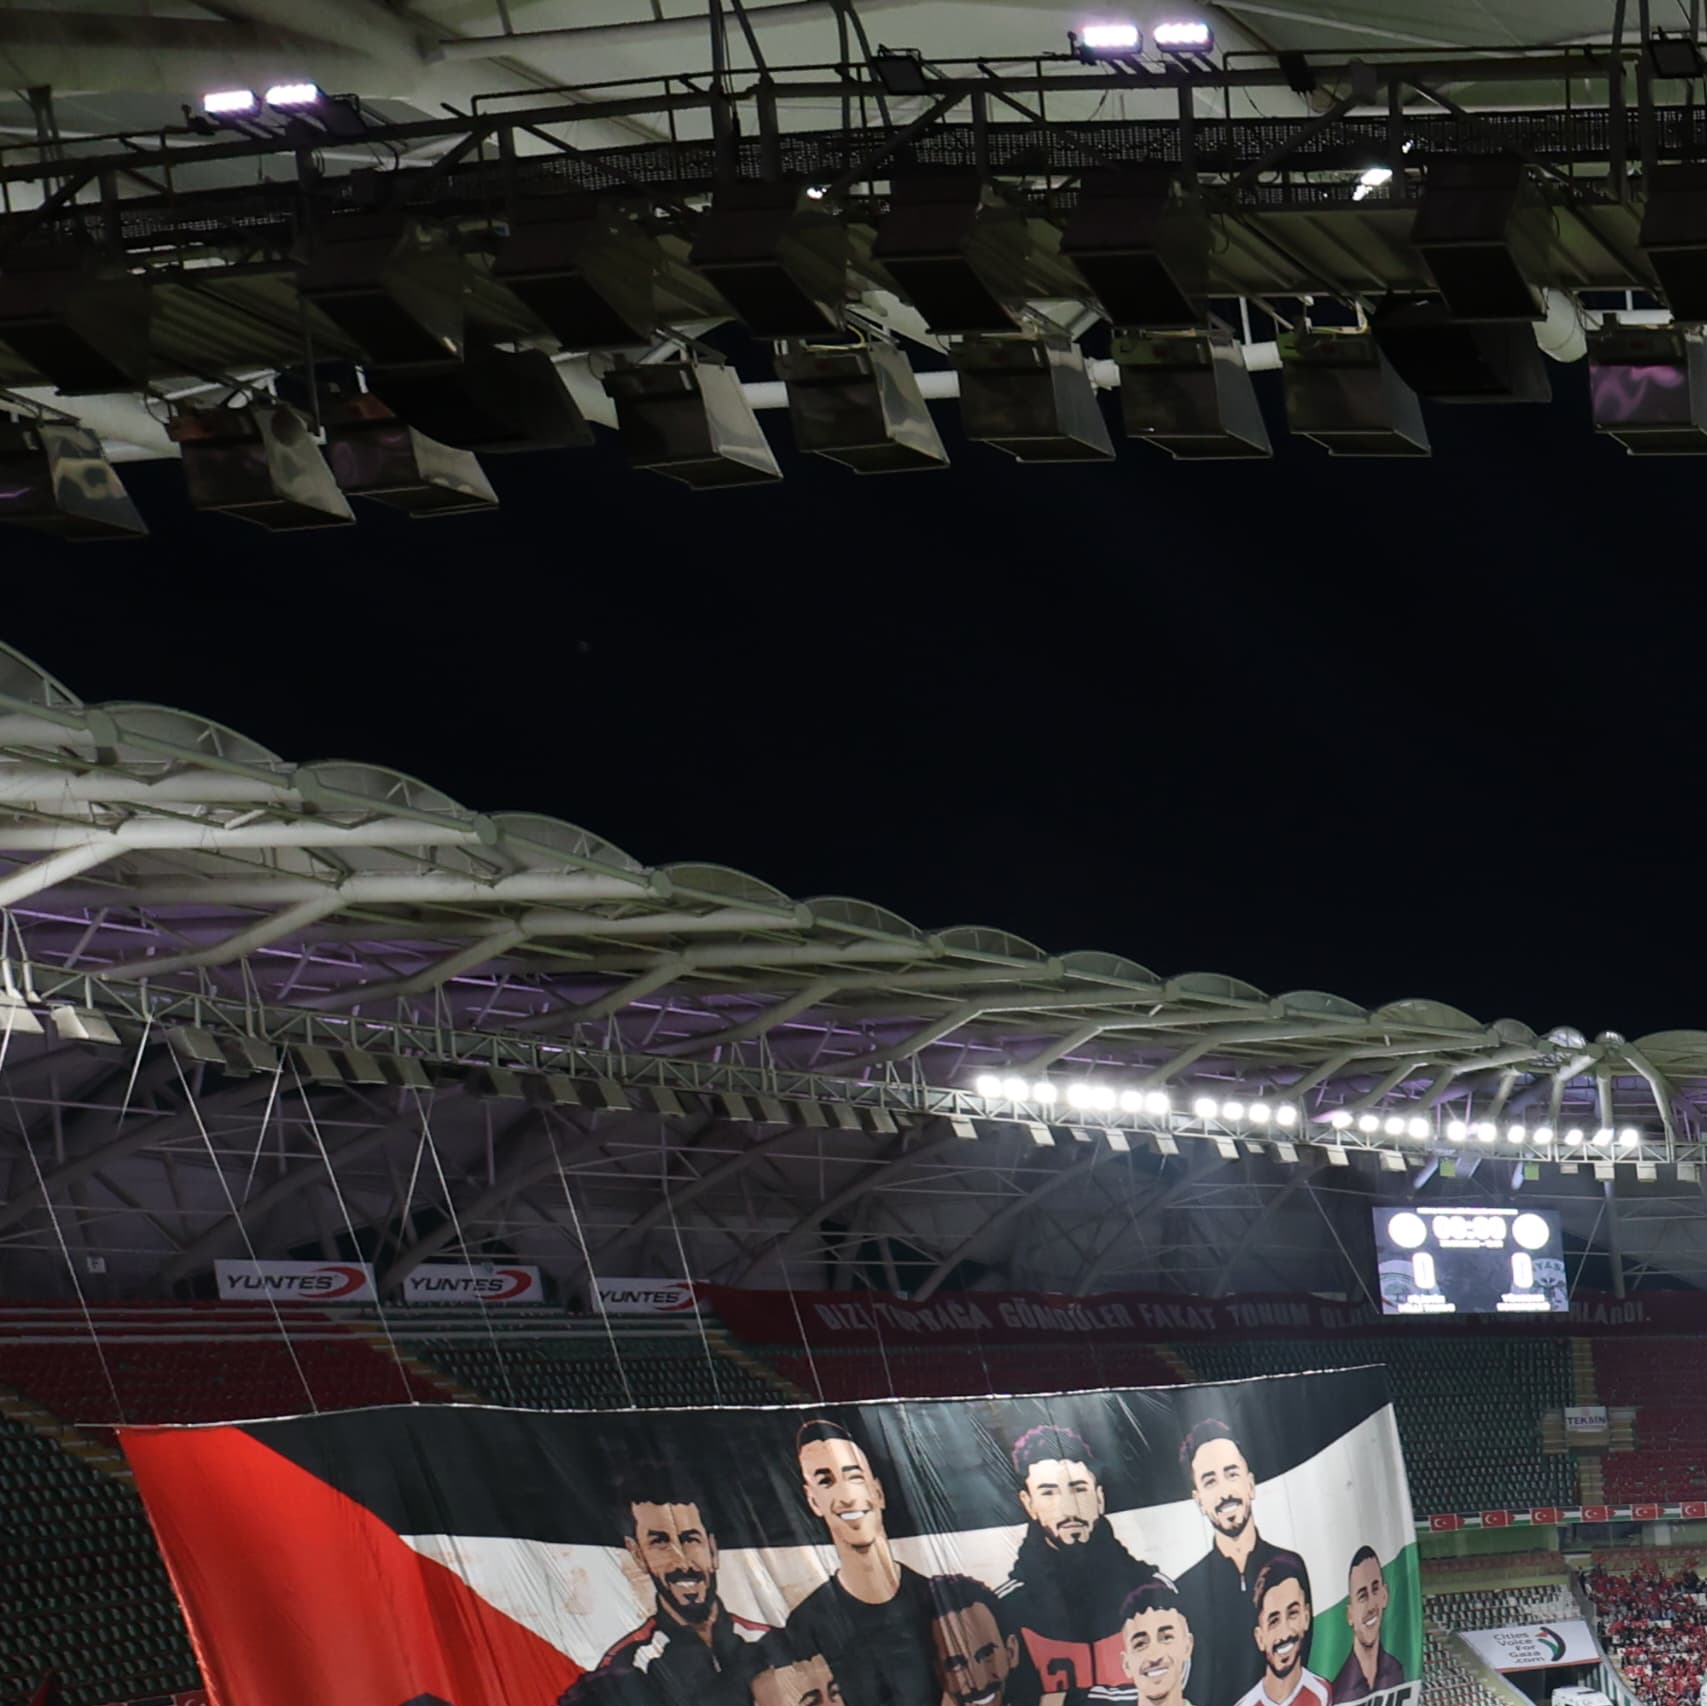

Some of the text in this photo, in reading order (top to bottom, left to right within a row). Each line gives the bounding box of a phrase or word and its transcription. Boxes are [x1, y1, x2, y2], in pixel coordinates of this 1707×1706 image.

[227, 1272, 335, 1293] YUNTES
[410, 1275, 503, 1293] YUNTES
[598, 1288, 681, 1307] YUNTES
[1493, 1632, 1529, 1641] Cities
